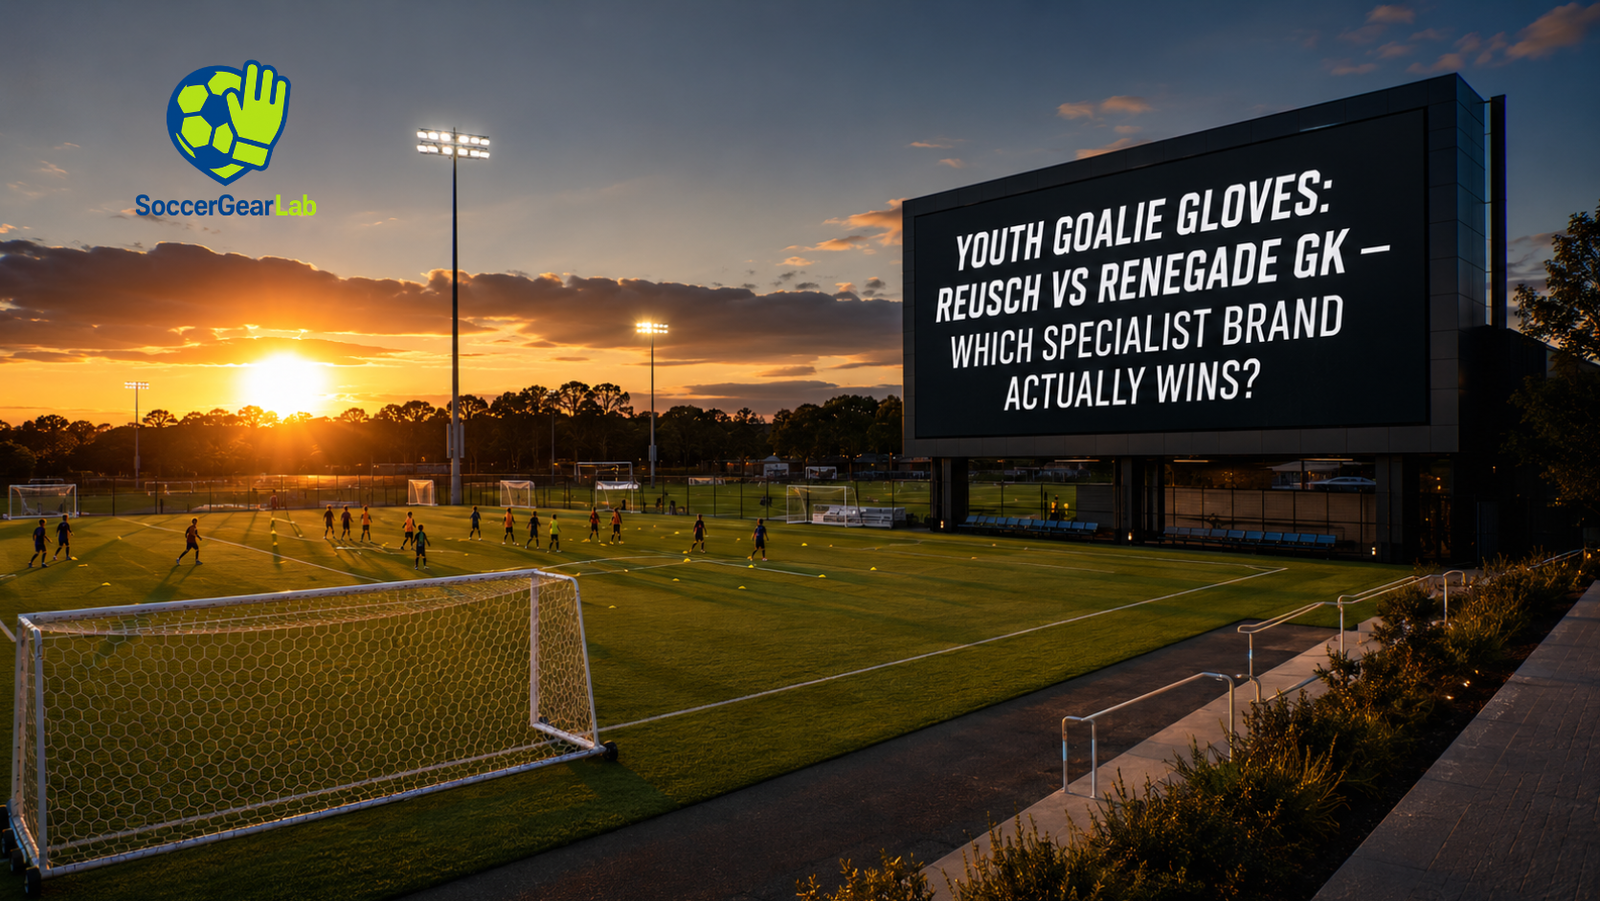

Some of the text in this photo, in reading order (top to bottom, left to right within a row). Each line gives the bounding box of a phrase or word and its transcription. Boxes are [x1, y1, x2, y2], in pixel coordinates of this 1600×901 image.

[956, 169, 1333, 272] YOUTH GOALIE GLOVES:
[935, 273, 1042, 323] REUSCH
[1052, 266, 1089, 309] VS
[1097, 237, 1282, 304] RENEGADE
[1293, 227, 1351, 279] GK
[950, 294, 1344, 369] WHICH SPECIALIST BRAND
[1003, 357, 1261, 411] ACTUALLY WINS?
